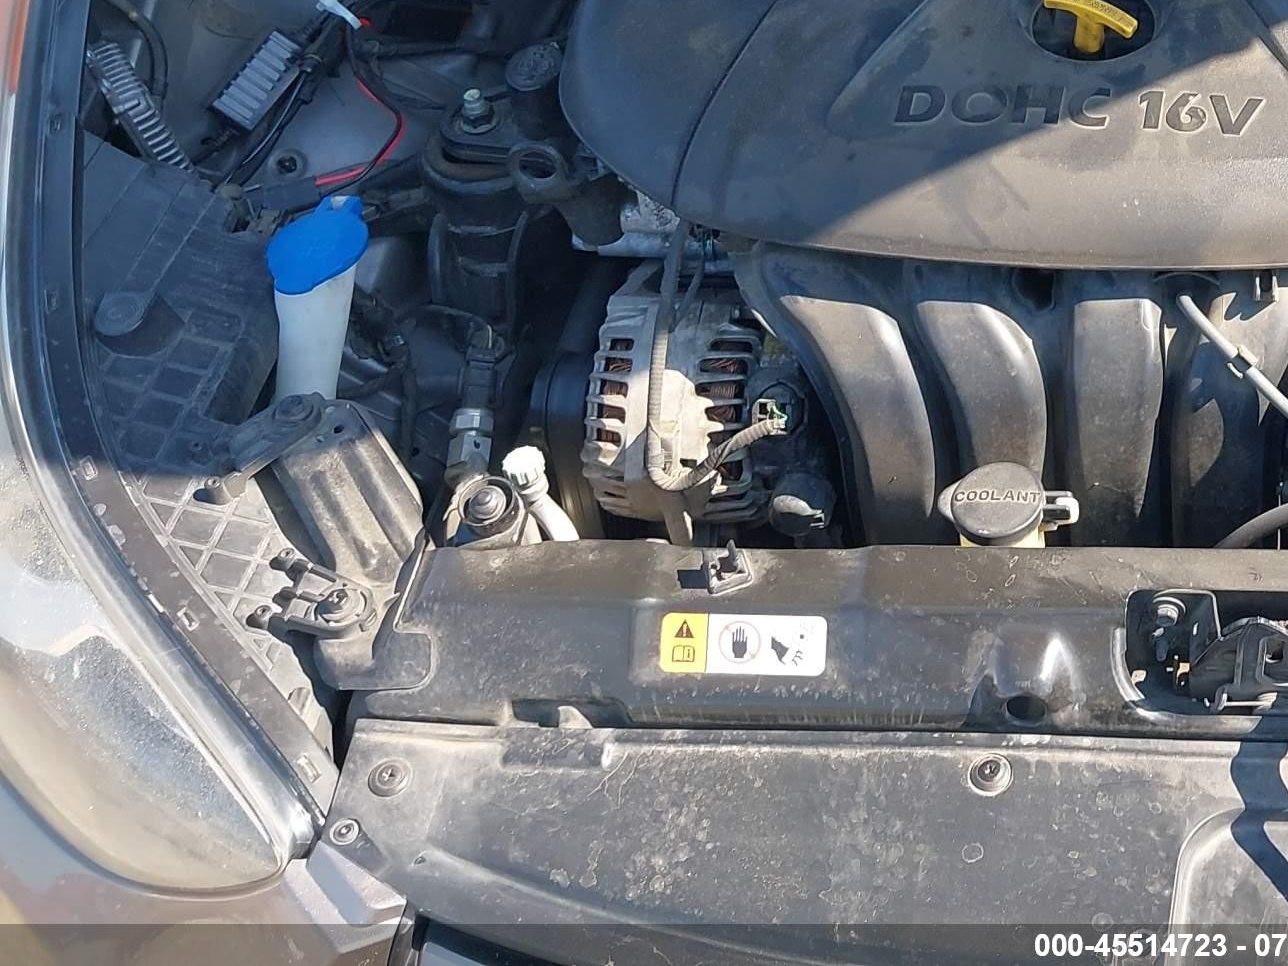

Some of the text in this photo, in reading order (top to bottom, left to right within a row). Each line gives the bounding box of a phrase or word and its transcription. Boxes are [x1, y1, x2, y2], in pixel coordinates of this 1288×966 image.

[894, 84, 1265, 136] DOHC 16V
[953, 489, 1041, 504] COOLANT
